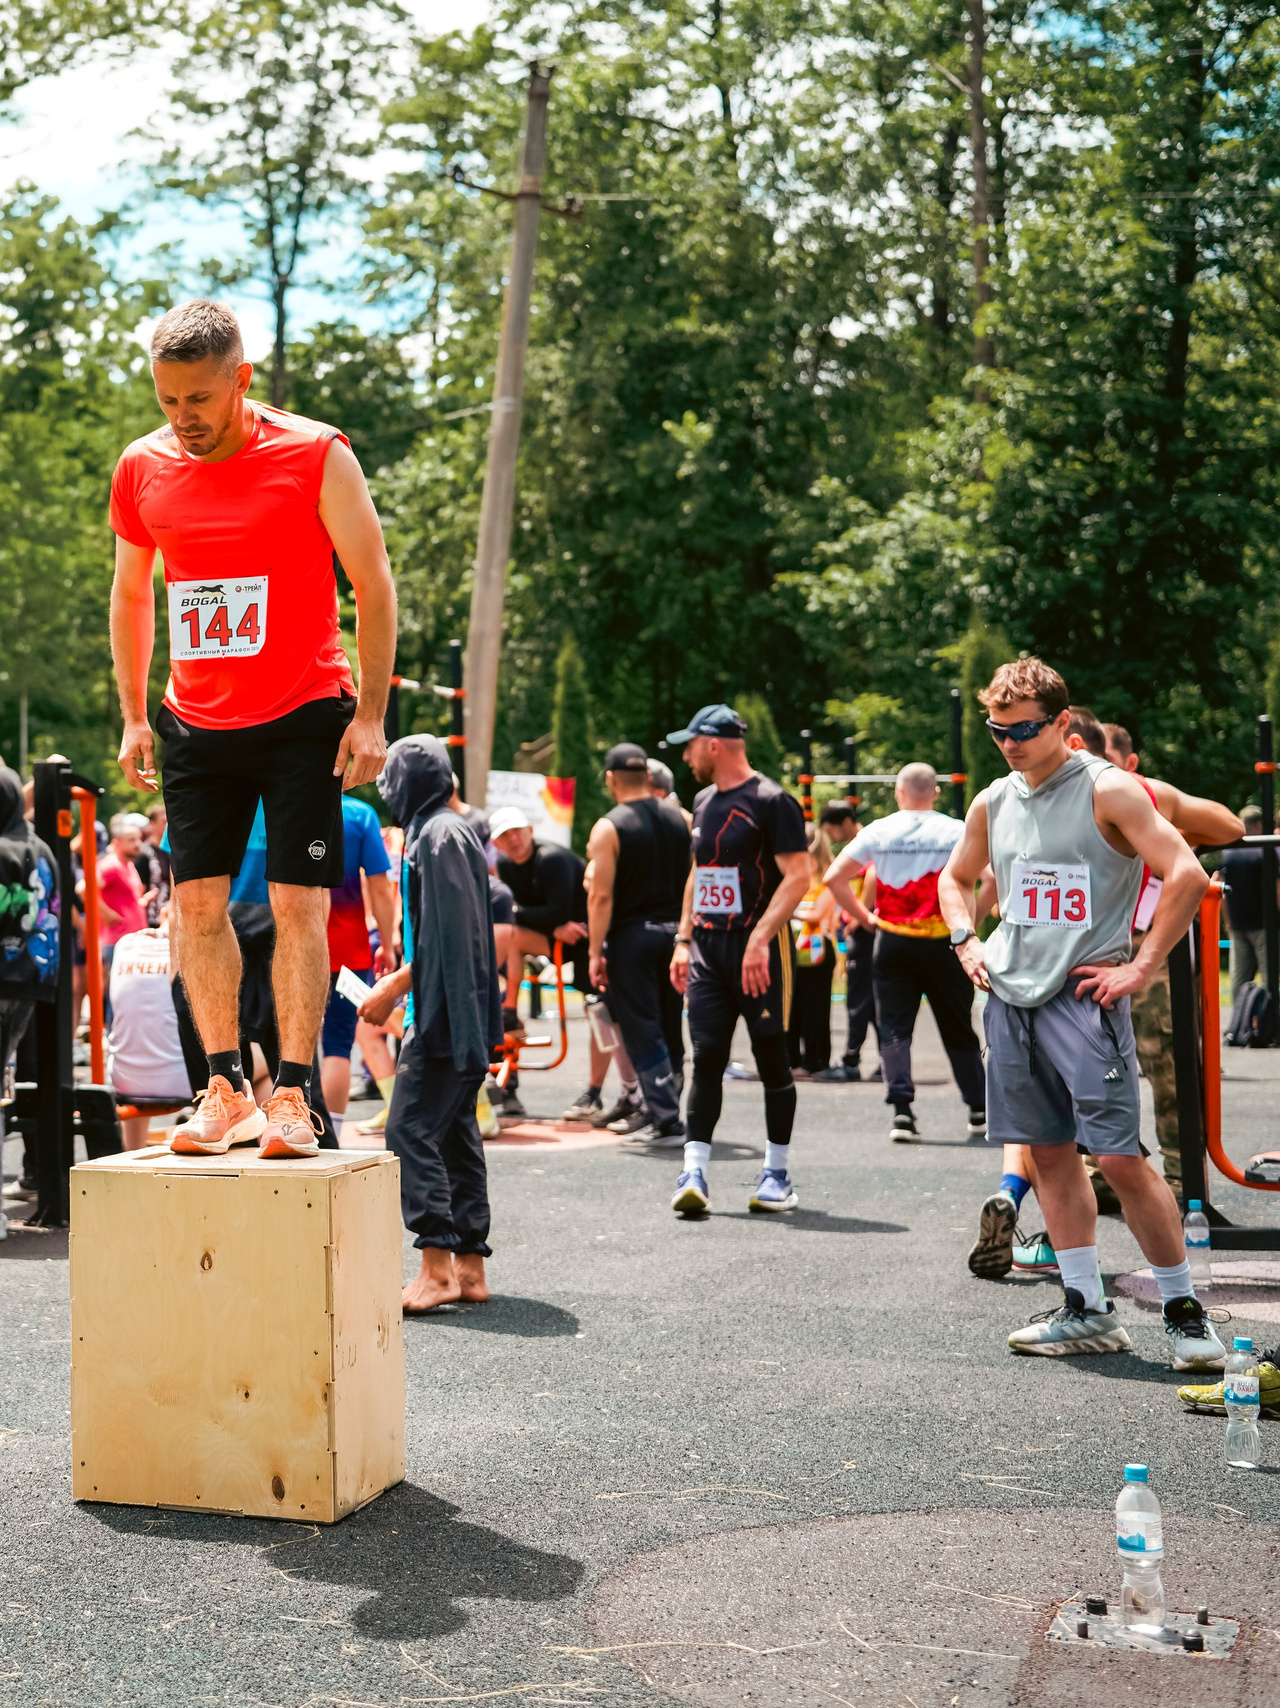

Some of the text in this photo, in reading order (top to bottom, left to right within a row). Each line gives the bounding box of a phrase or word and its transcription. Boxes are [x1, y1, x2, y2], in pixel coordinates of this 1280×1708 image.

[181, 596, 227, 607] BOGAL
[181, 603, 261, 648] 144
[1022, 877, 1059, 886] BOGAL
[700, 885, 735, 907] 259
[1023, 887, 1087, 921] 113
